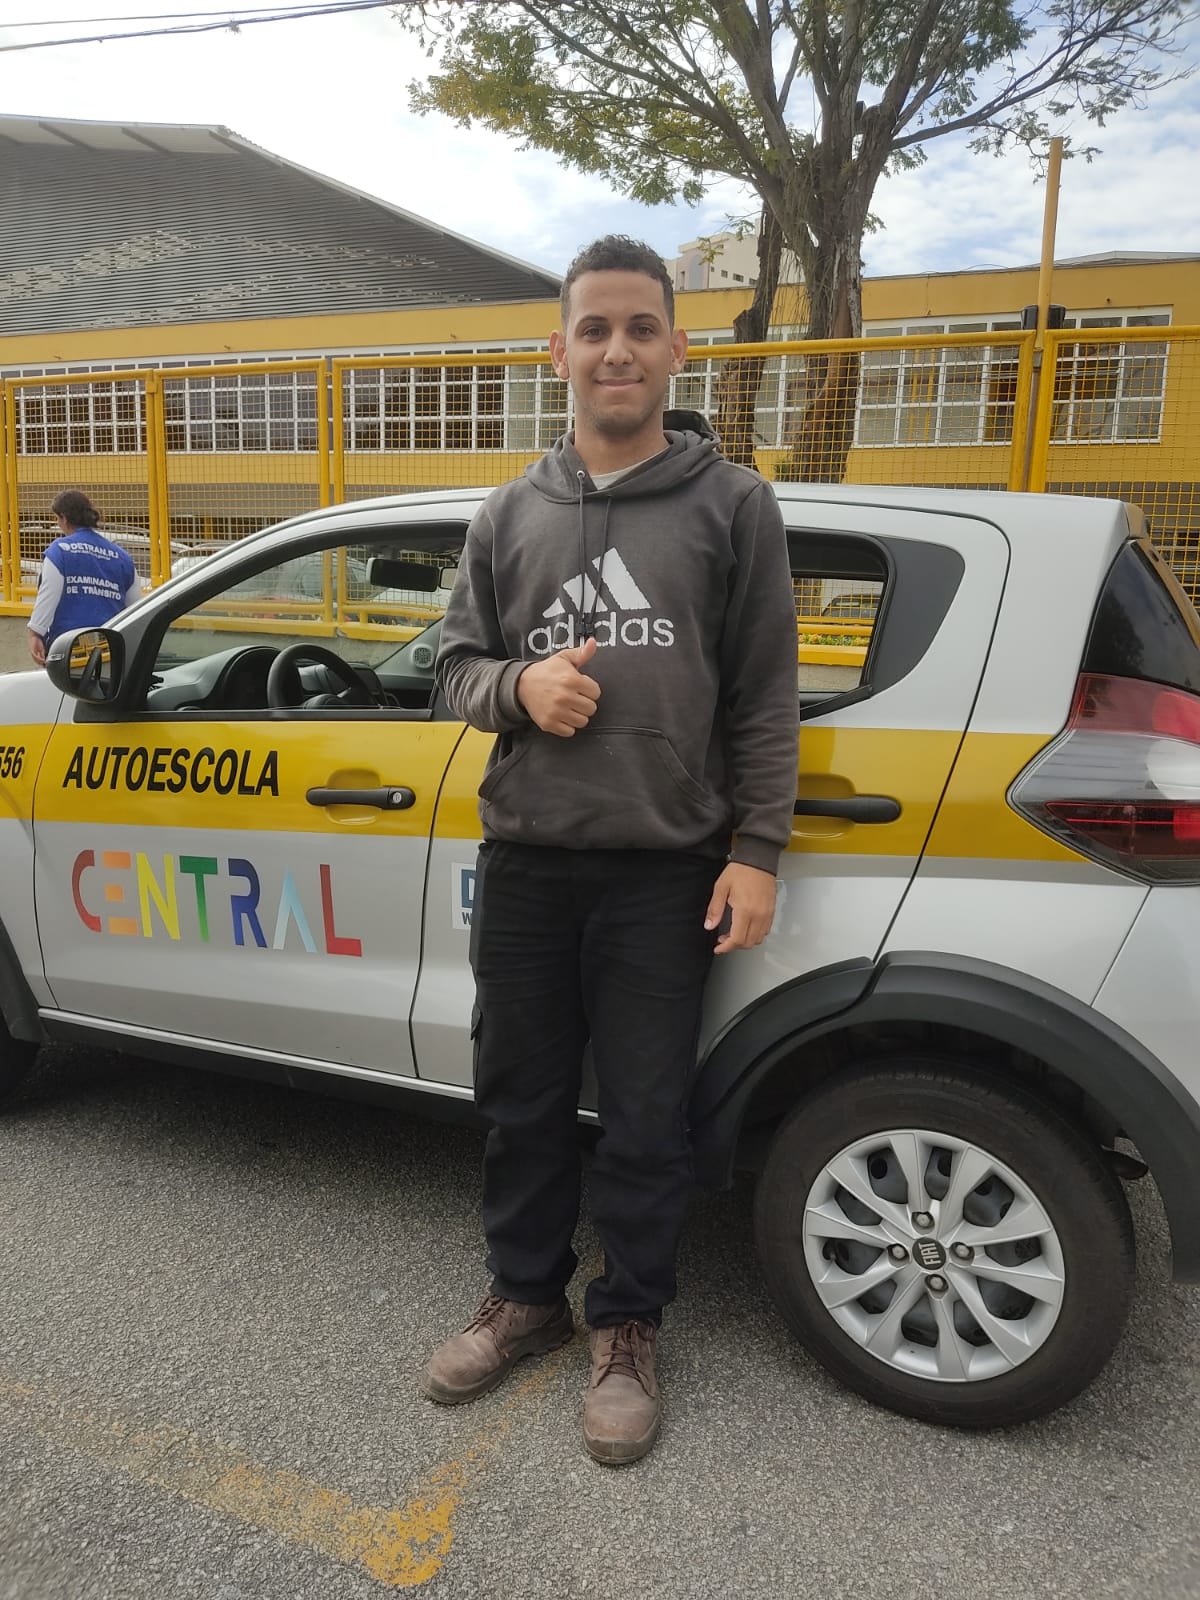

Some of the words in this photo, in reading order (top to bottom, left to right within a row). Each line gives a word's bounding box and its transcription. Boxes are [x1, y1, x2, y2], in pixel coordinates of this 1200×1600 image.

[70, 543, 119, 558] DETRAN.RJ
[66, 576, 119, 591] EXAMINADOR
[66, 586, 78, 594] DE
[62, 746, 279, 796] AUTOESCOLA
[72, 849, 362, 957] CENTRAL
[918, 1243, 941, 1265] FIAT
